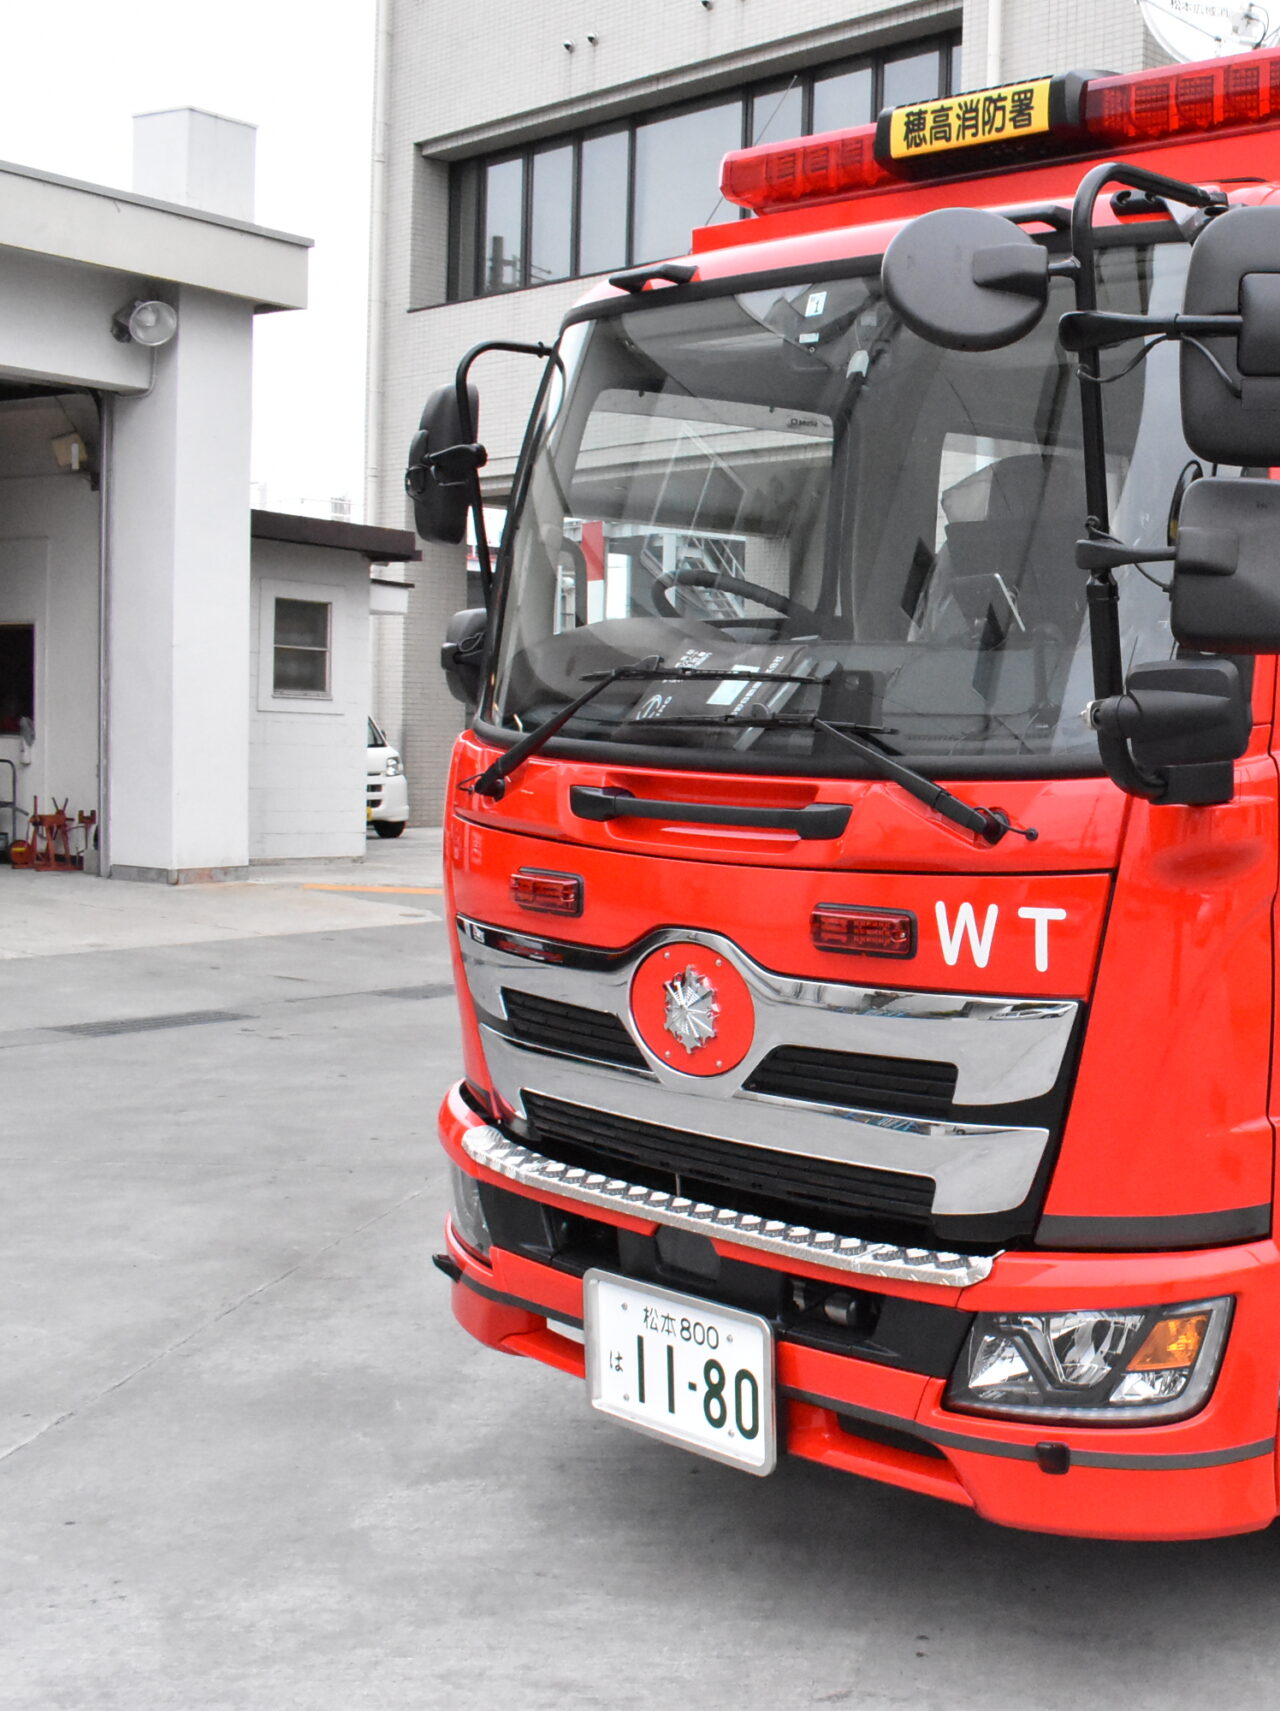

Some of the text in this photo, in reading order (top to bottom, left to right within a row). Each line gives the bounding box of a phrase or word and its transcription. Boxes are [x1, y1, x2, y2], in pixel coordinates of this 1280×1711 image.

[904, 88, 1034, 150] 穂高消防署
[609, 1334, 760, 1441] は 11-80
